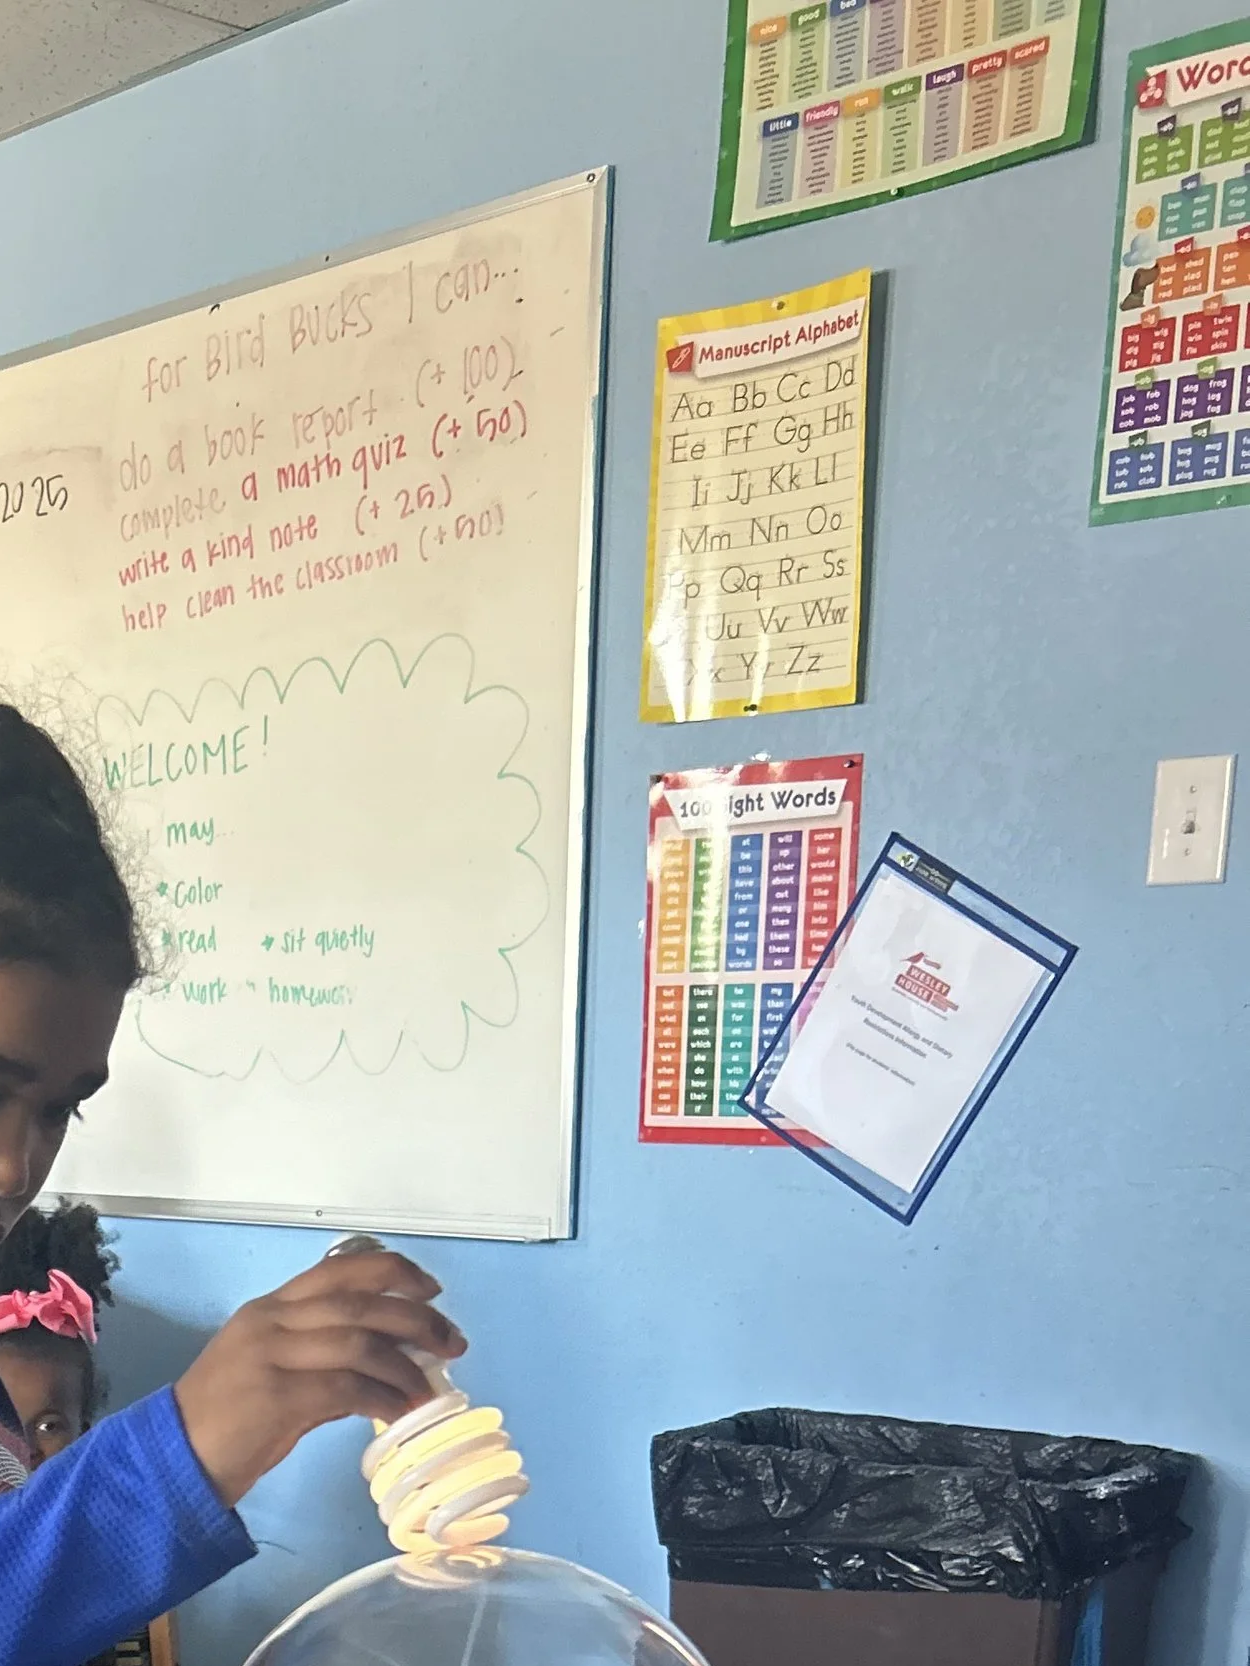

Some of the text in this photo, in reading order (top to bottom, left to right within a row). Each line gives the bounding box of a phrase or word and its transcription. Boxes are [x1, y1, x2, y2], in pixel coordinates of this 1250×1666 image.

[972, 56, 1003, 74] pretty
[1014, 42, 1045, 59] scared
[933, 70, 957, 84] laugh
[806, 105, 839, 122] friendly
[698, 308, 861, 365] Manuscript Alphabet
[670, 360, 855, 423] Aa Bb Cc Dd
[1183, 384, 1199, 393] dog
[1209, 380, 1227, 388] frog
[670, 406, 854, 464] Ee Ff Gg Hh
[119, 446, 152, 493] do
[166, 446, 186, 475] a
[205, 418, 266, 468] book
[241, 470, 260, 502] a
[276, 449, 343, 493] math
[351, 433, 407, 490] quiz
[725, 471, 752, 506] Jj
[768, 463, 802, 496] Kk
[678, 505, 842, 555] Mm Nn Oo
[118, 549, 171, 588] write
[181, 549, 198, 574] a
[206, 524, 255, 569] kind
[269, 512, 319, 554] note
[122, 604, 168, 633] help
[185, 582, 236, 620] clean
[246, 572, 285, 600] the
[295, 539, 400, 592] classroom
[720, 564, 761, 601] Qq
[778, 557, 808, 588] Rr
[823, 549, 846, 580] Ss
[705, 597, 848, 641] Uu Vv Ww
[787, 645, 822, 676] Zz
[102, 715, 270, 791] WELCOME!
[726, 793, 765, 818] ight
[770, 786, 837, 810] Words
[178, 923, 375, 959] read sit quietly
[182, 977, 228, 1005] work
[898, 976, 930, 1000] HOUSE
[910, 966, 950, 994] WESLEY
